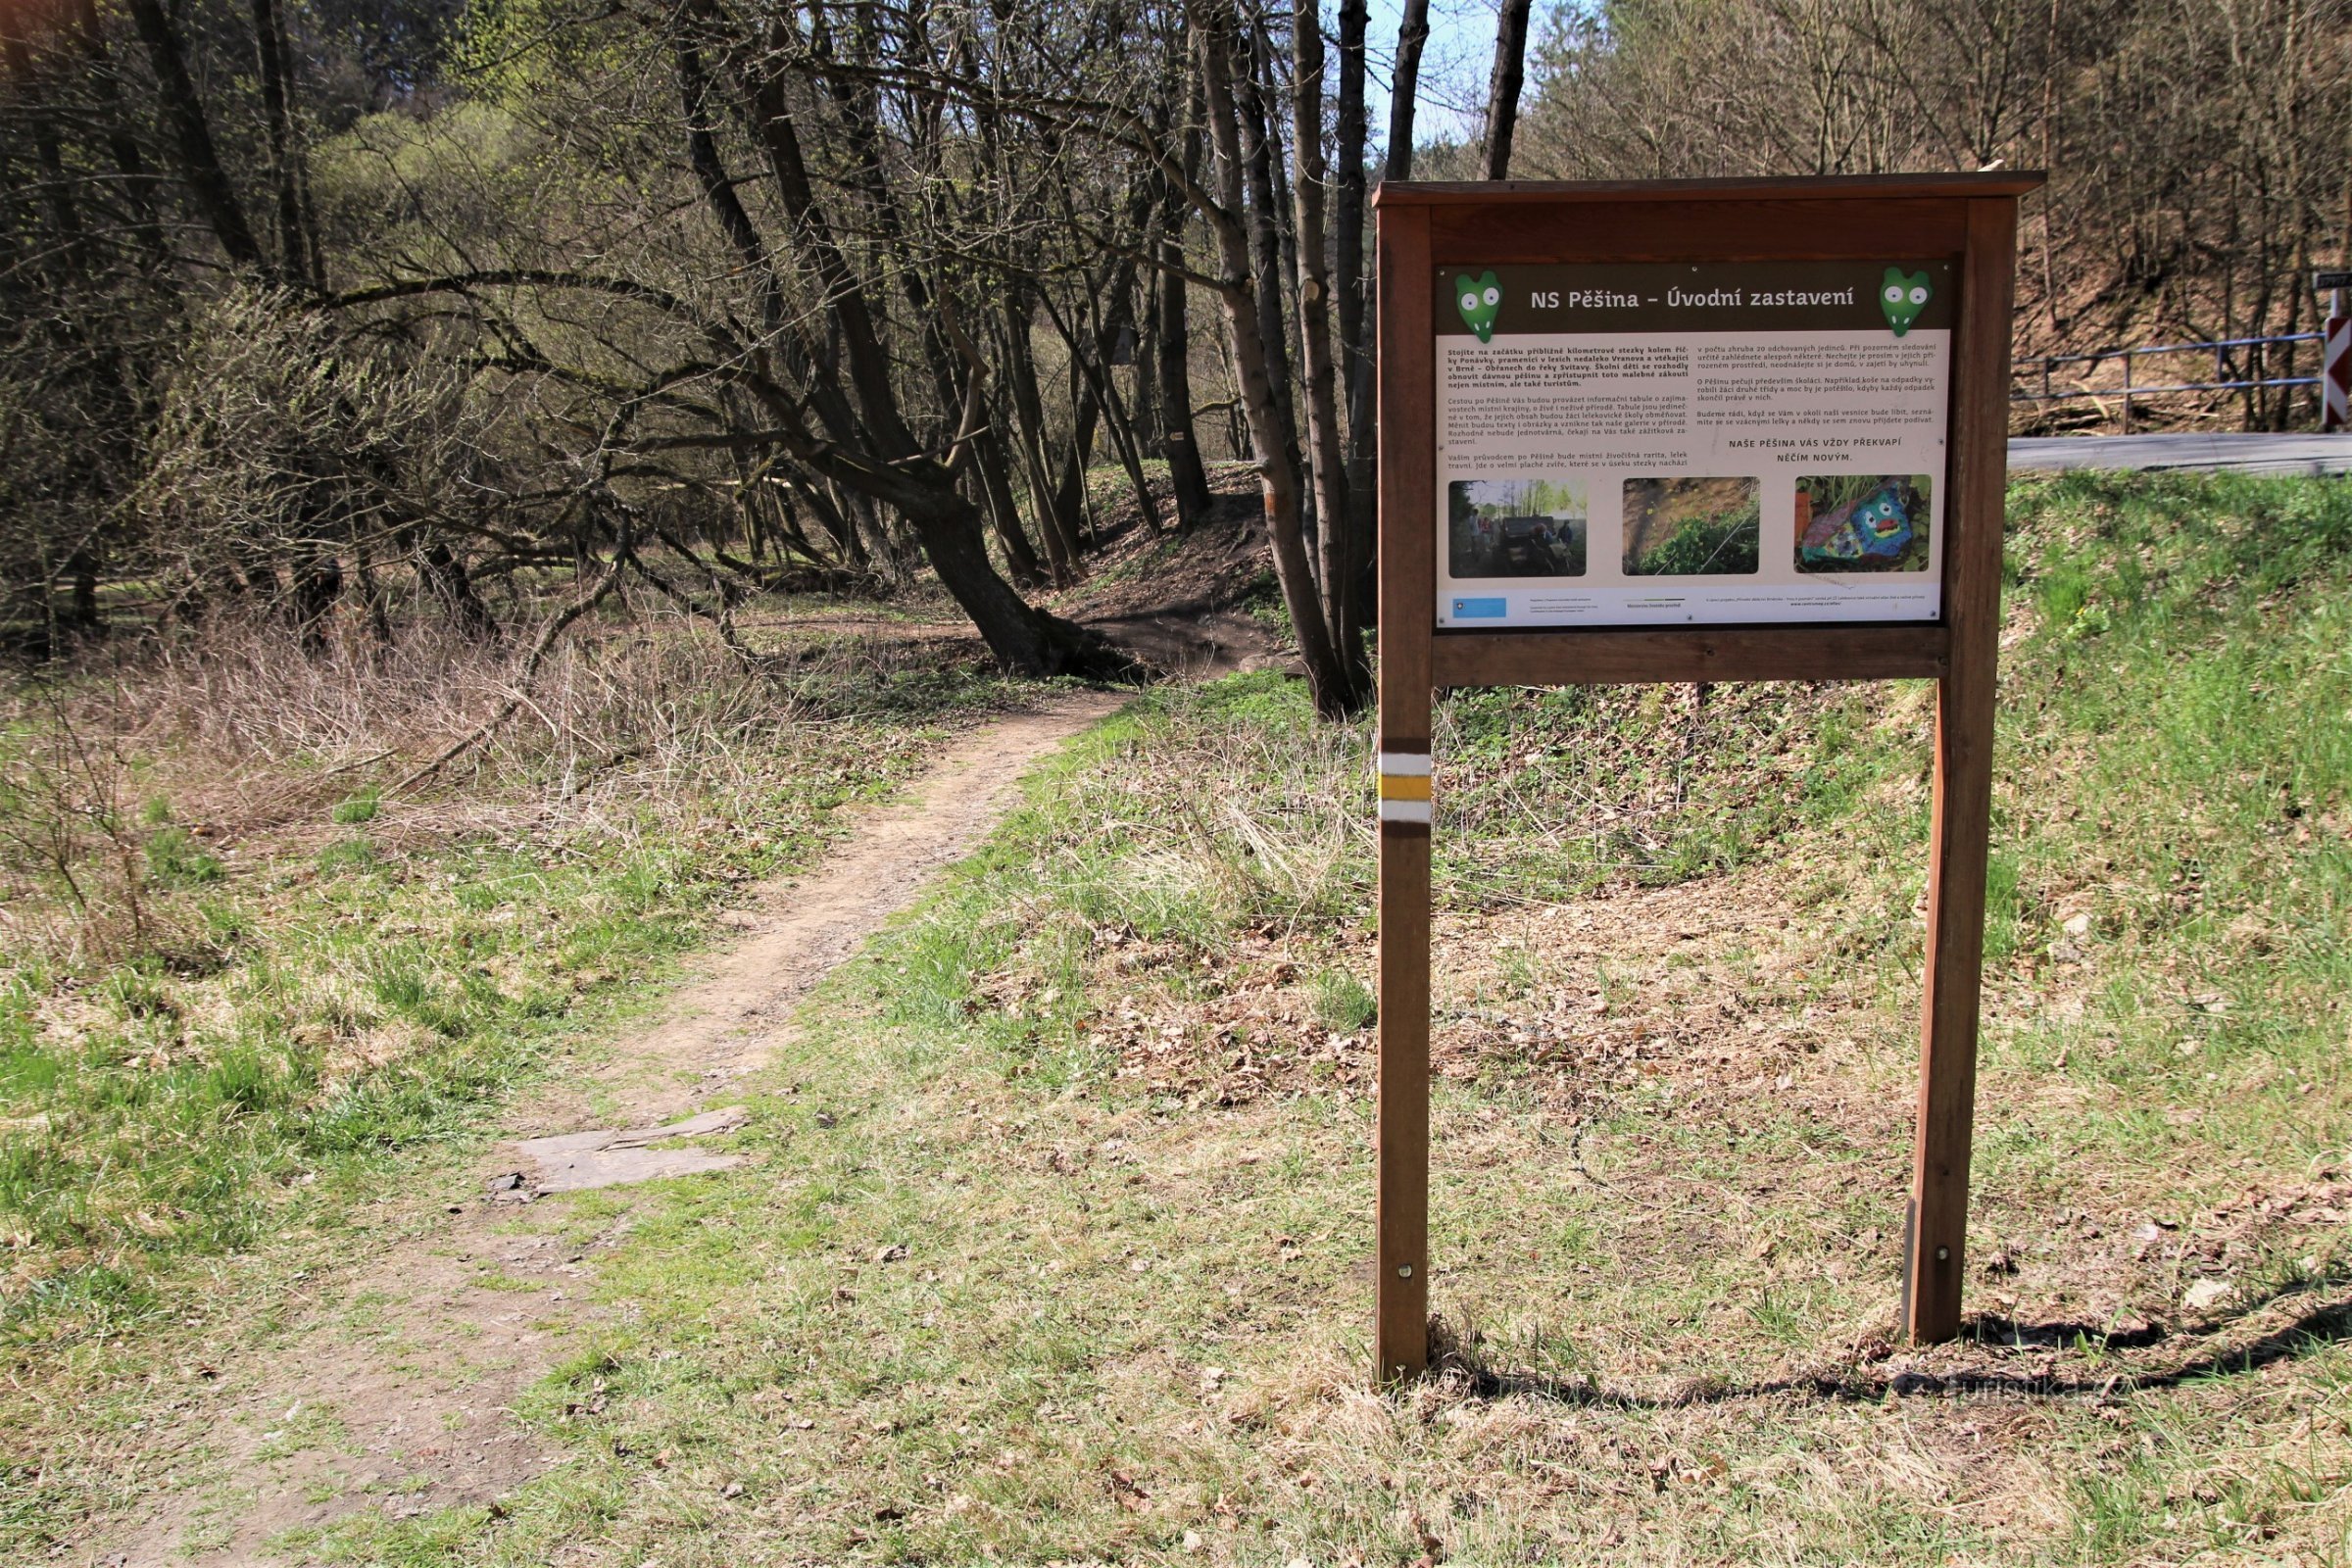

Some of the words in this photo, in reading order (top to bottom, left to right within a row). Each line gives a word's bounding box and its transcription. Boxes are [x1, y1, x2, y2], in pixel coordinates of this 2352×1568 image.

[1531, 292, 1559, 309] NS
[1569, 290, 1639, 308] Pěšina
[1667, 286, 1741, 307] Úvodní
[1750, 287, 1853, 307] zastavení
[1447, 348, 1475, 358] Stojíte
[1527, 347, 1564, 357] přibližně
[1618, 346, 1644, 356] stezky
[1447, 357, 1457, 366] ky
[1497, 356, 1539, 366] pramenící
[1654, 354, 1690, 364] vtékající
[1455, 364, 1475, 372] Brně
[1485, 364, 1524, 372] Obřanech
[1538, 363, 1557, 373] řeky
[1559, 363, 1592, 372] Svitavy.
[1622, 362, 1640, 370] děti
[1653, 362, 1690, 371] rozhodly
[1482, 371, 1511, 380] dávnou
[1514, 371, 1542, 381] pěšinu
[1552, 370, 1599, 381] zpřístupnit
[1447, 380, 1470, 390] nejen
[1472, 380, 1507, 389] místním,
[1729, 438, 1756, 448] NAŠE
[1759, 438, 1796, 447] PĚŠINA
[1799, 438, 1819, 447] VÁS
[1823, 437, 1850, 447] VŽDY
[1852, 437, 1901, 446] PŘEKVAPÍ
[1777, 453, 1809, 462] NĚČÍM
[1813, 452, 1853, 462] NOVÝM.
